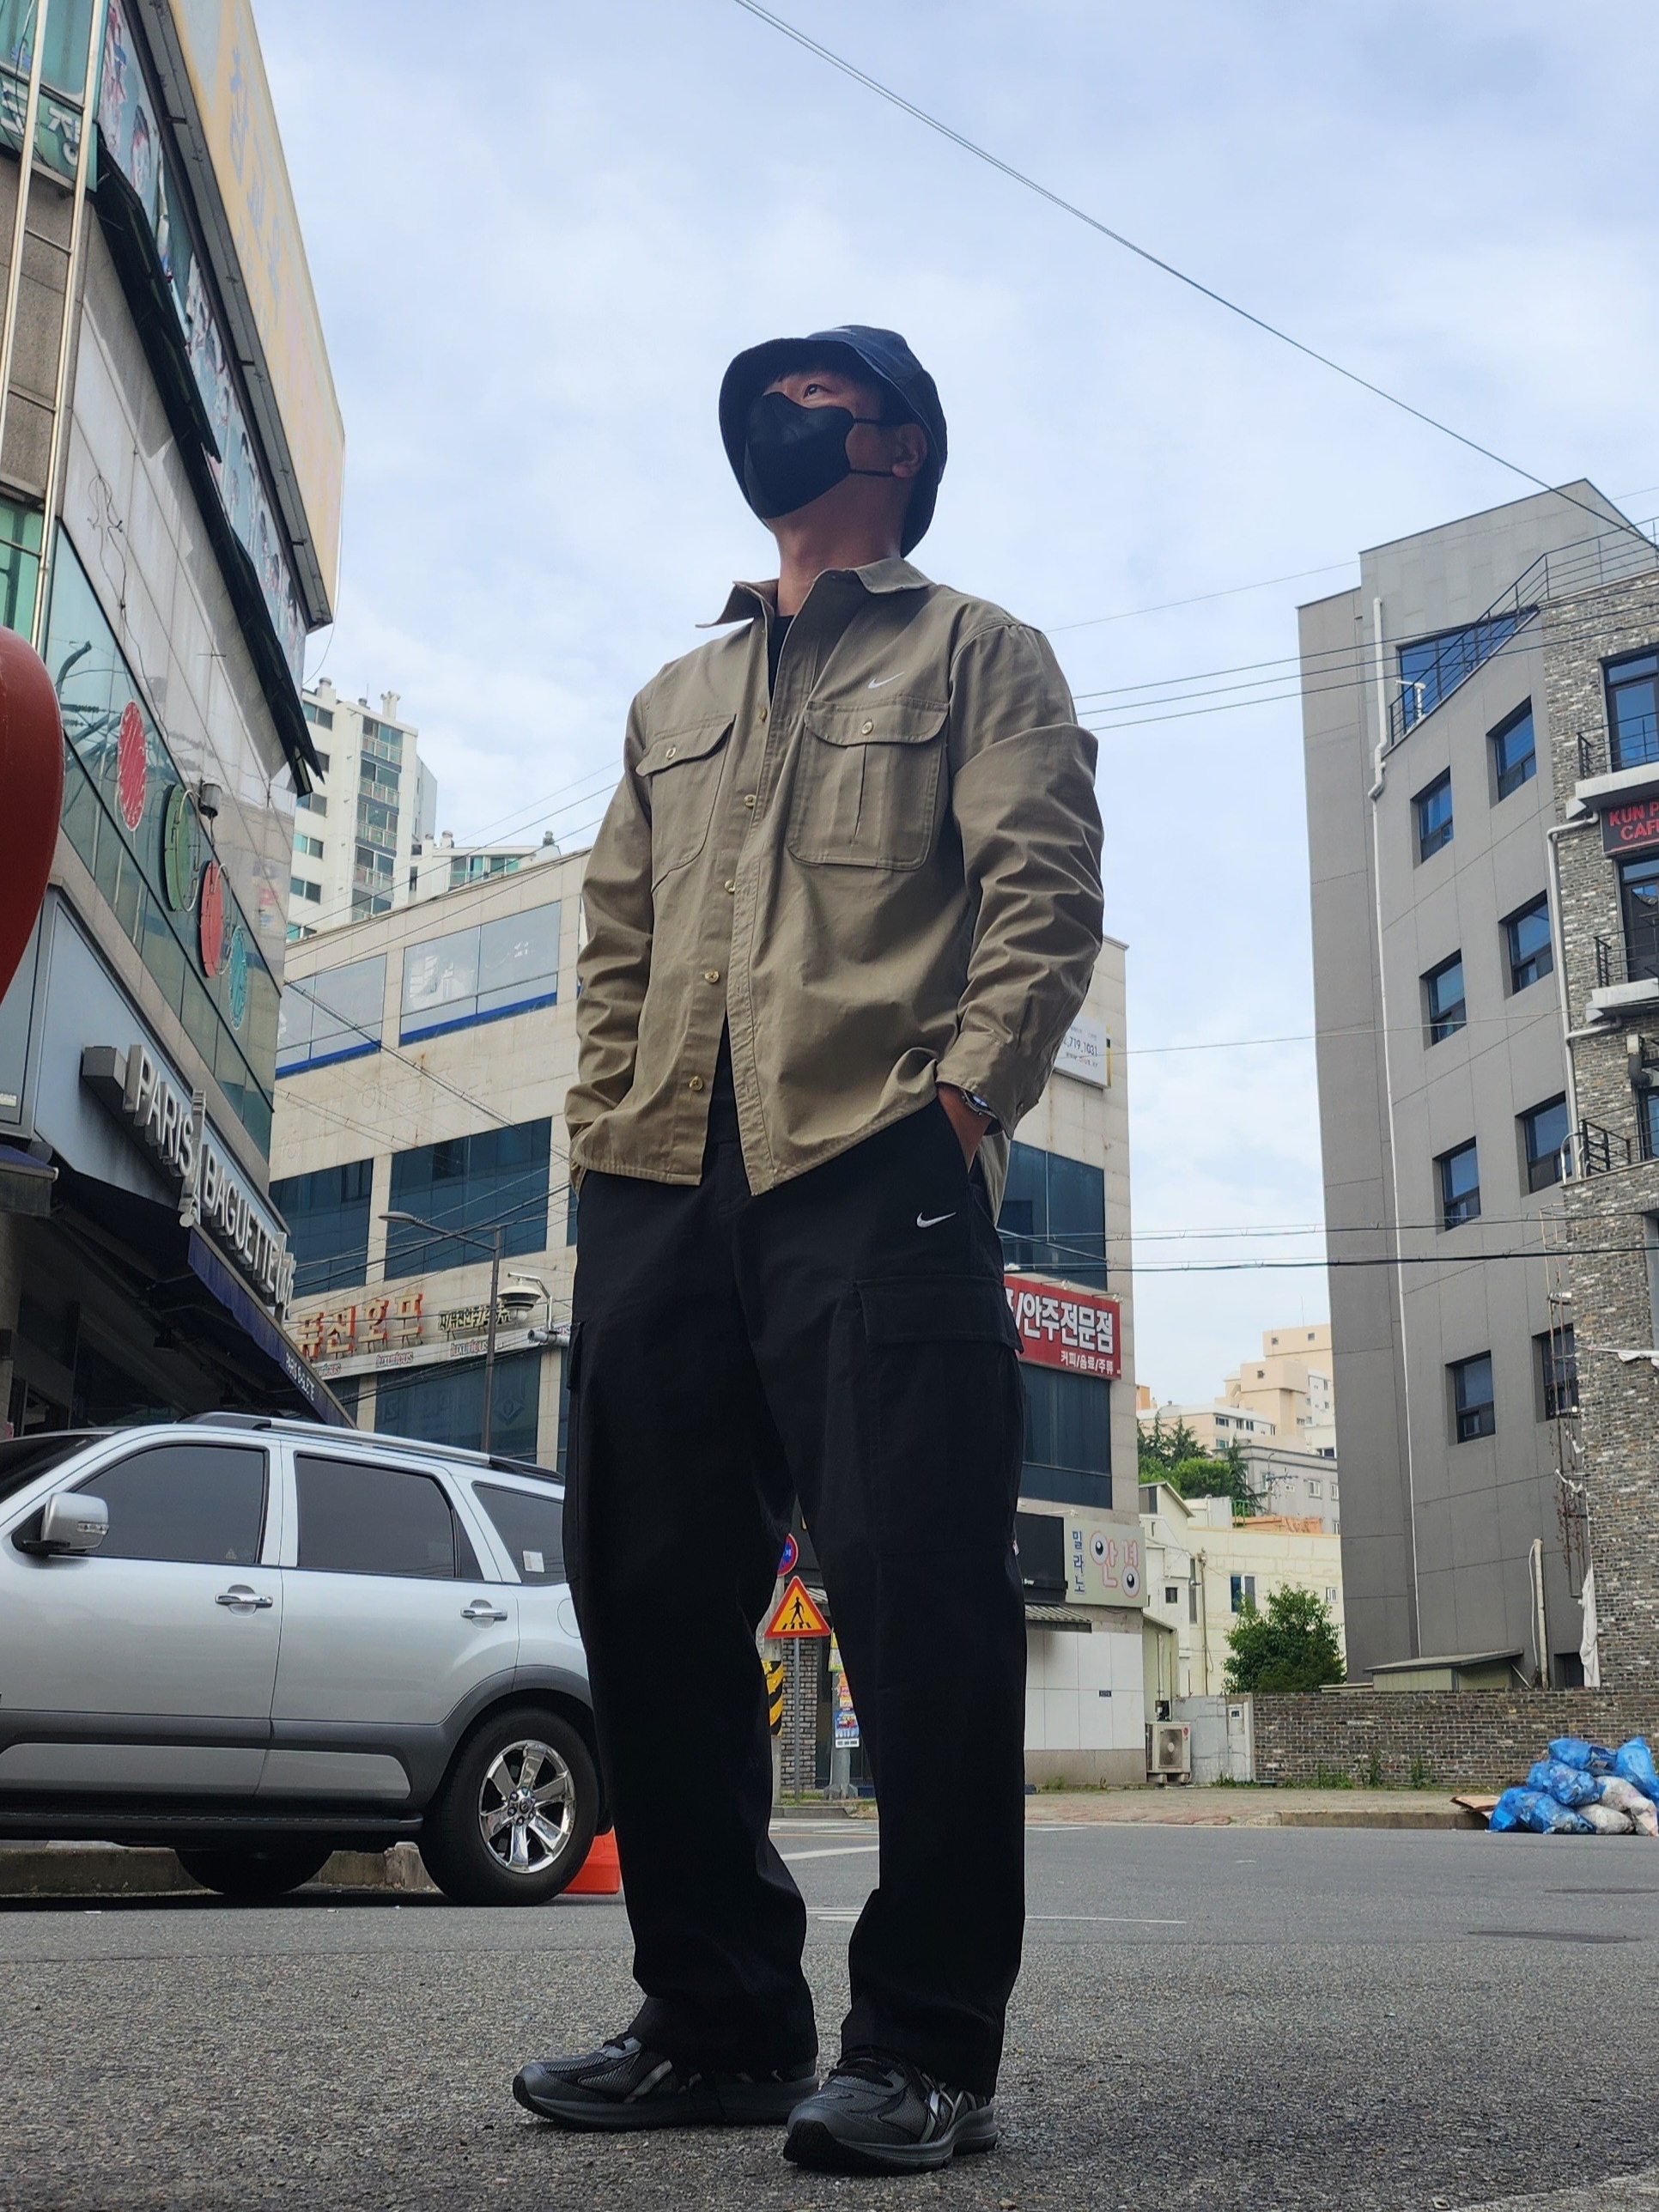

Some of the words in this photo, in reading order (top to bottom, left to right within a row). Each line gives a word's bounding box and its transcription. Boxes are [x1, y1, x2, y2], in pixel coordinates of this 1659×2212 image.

[1609, 805, 1645, 827] KUN
[126, 1044, 194, 1177] PARIS
[1060, 1350, 1114, 1375] 커피/음료/주류
[1073, 1531, 1085, 1595] 밀라노
[1090, 1530, 1140, 1598] 안경
